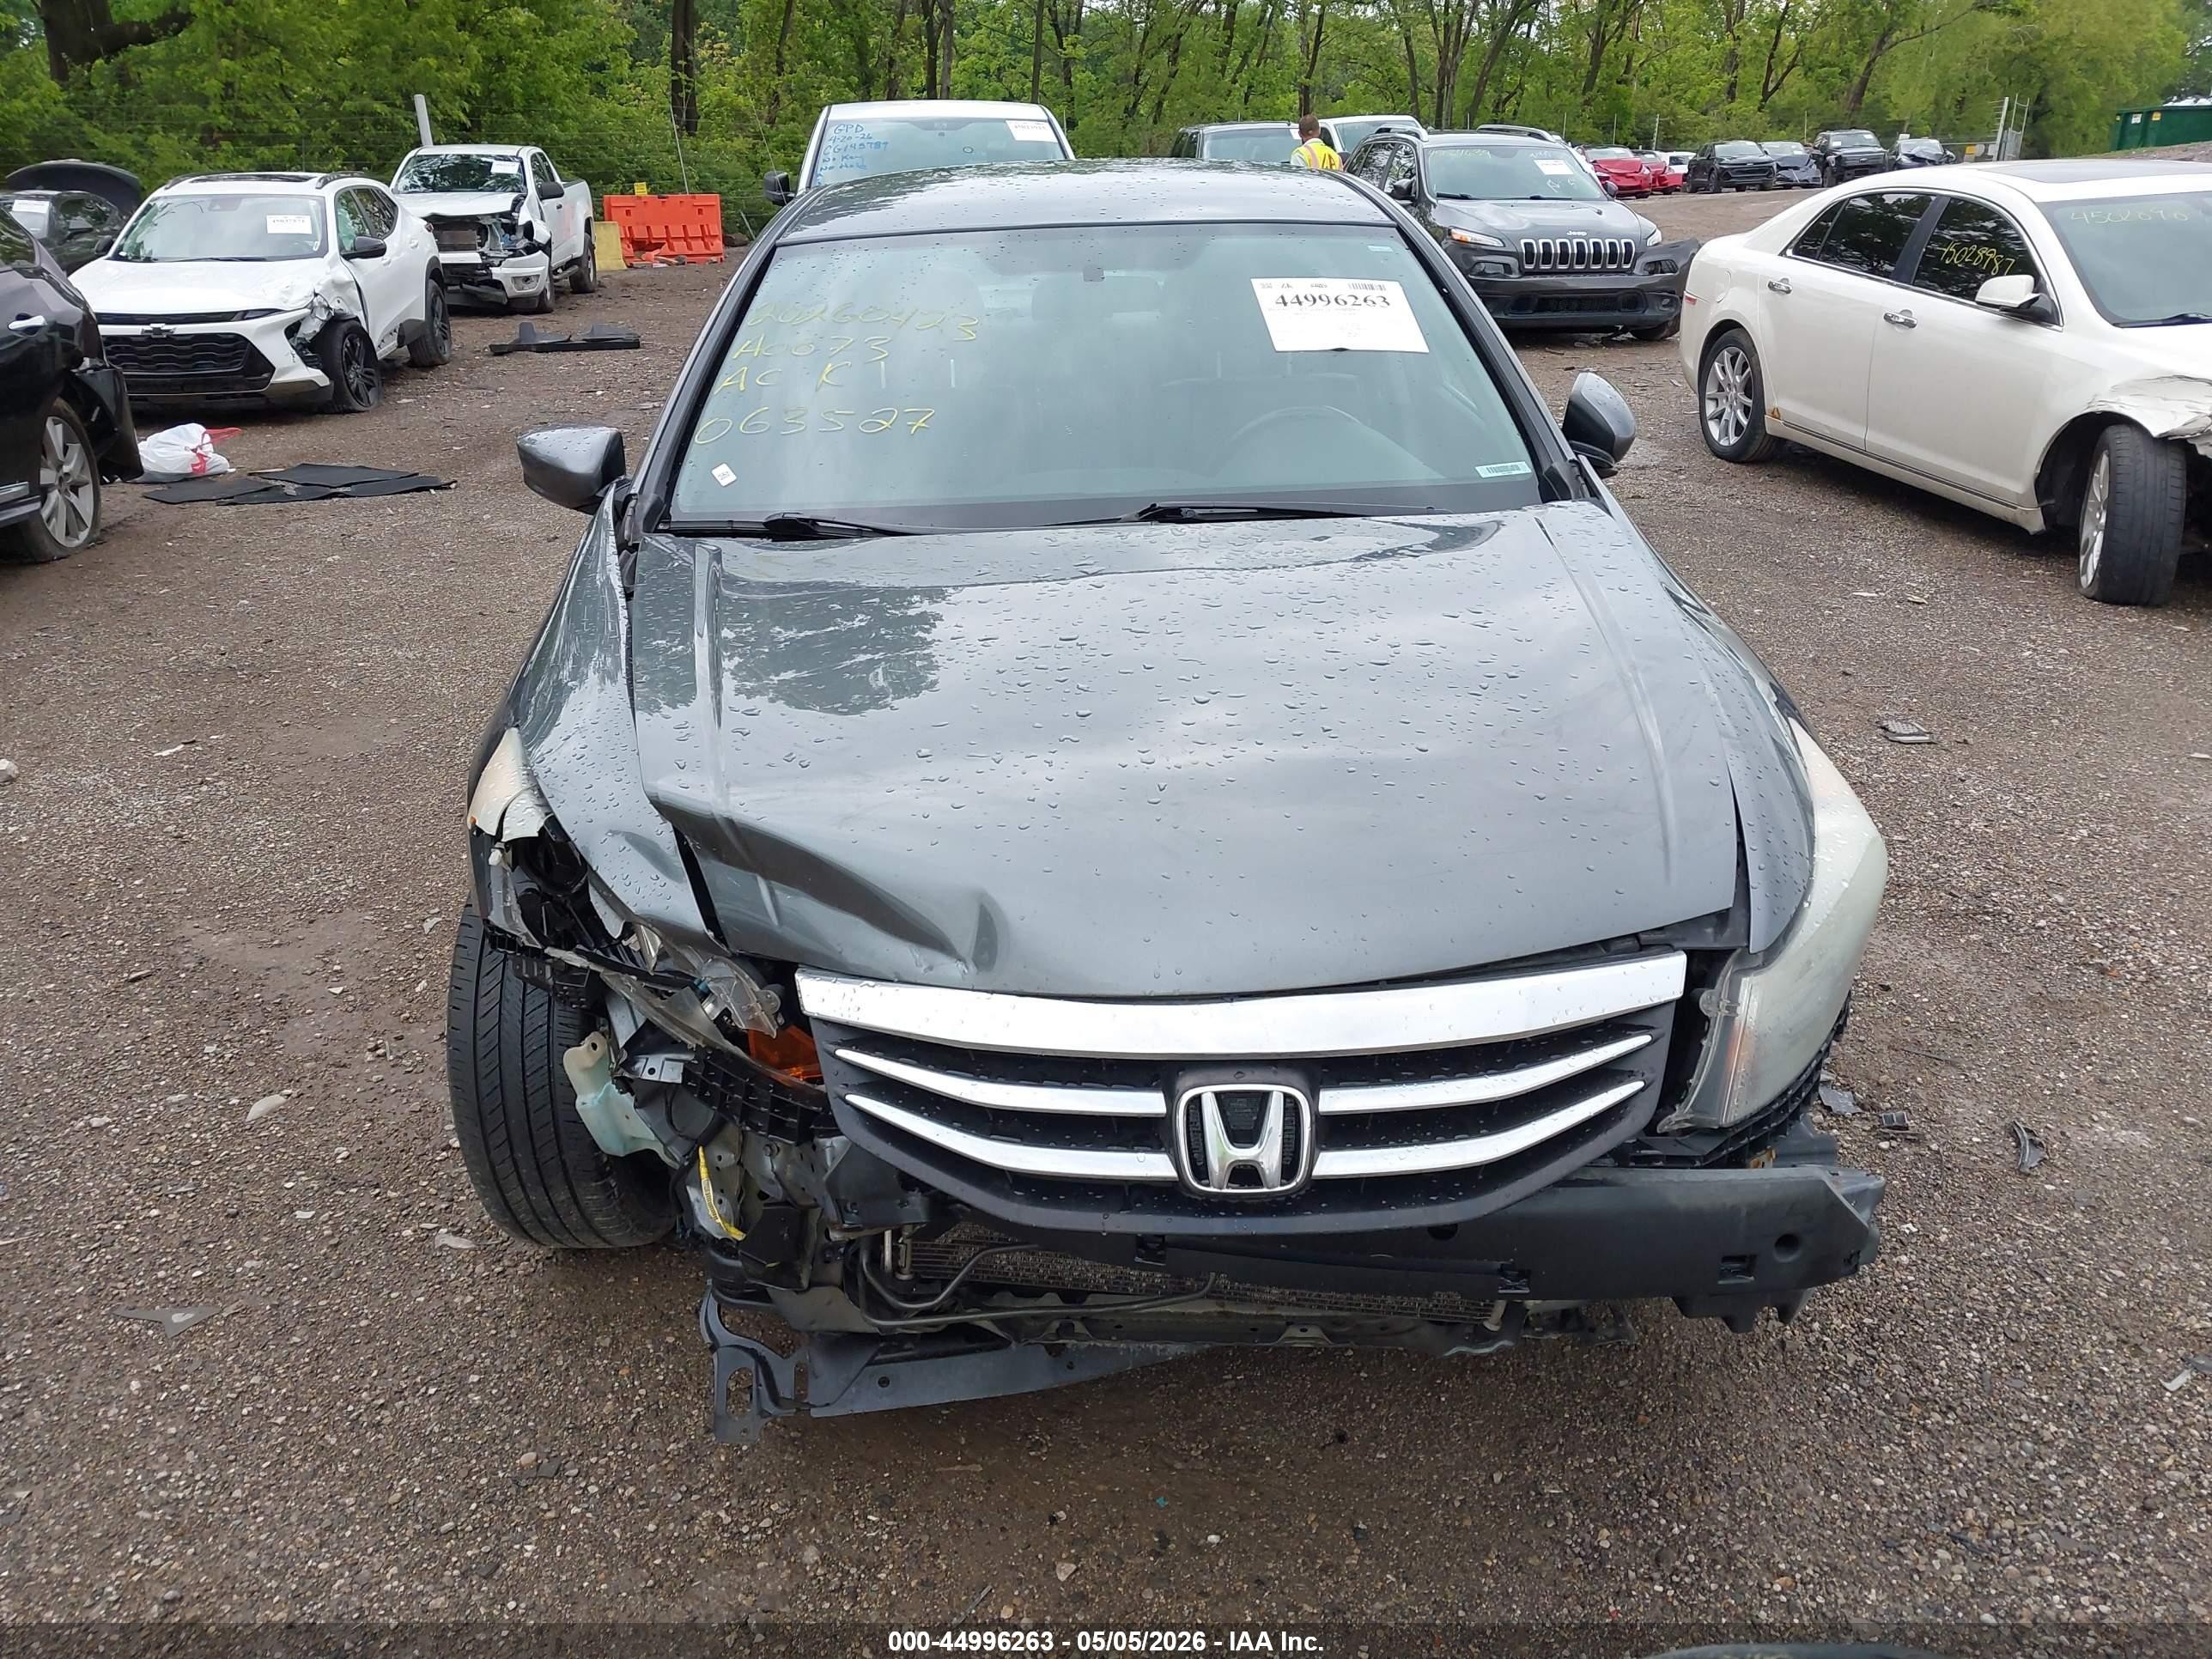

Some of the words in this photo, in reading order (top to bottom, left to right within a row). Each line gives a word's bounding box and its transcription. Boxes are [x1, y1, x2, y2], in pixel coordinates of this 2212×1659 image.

[834, 124, 865, 135] GPD
[1275, 293, 1391, 308] 44996263
[695, 407, 935, 445] 063527
